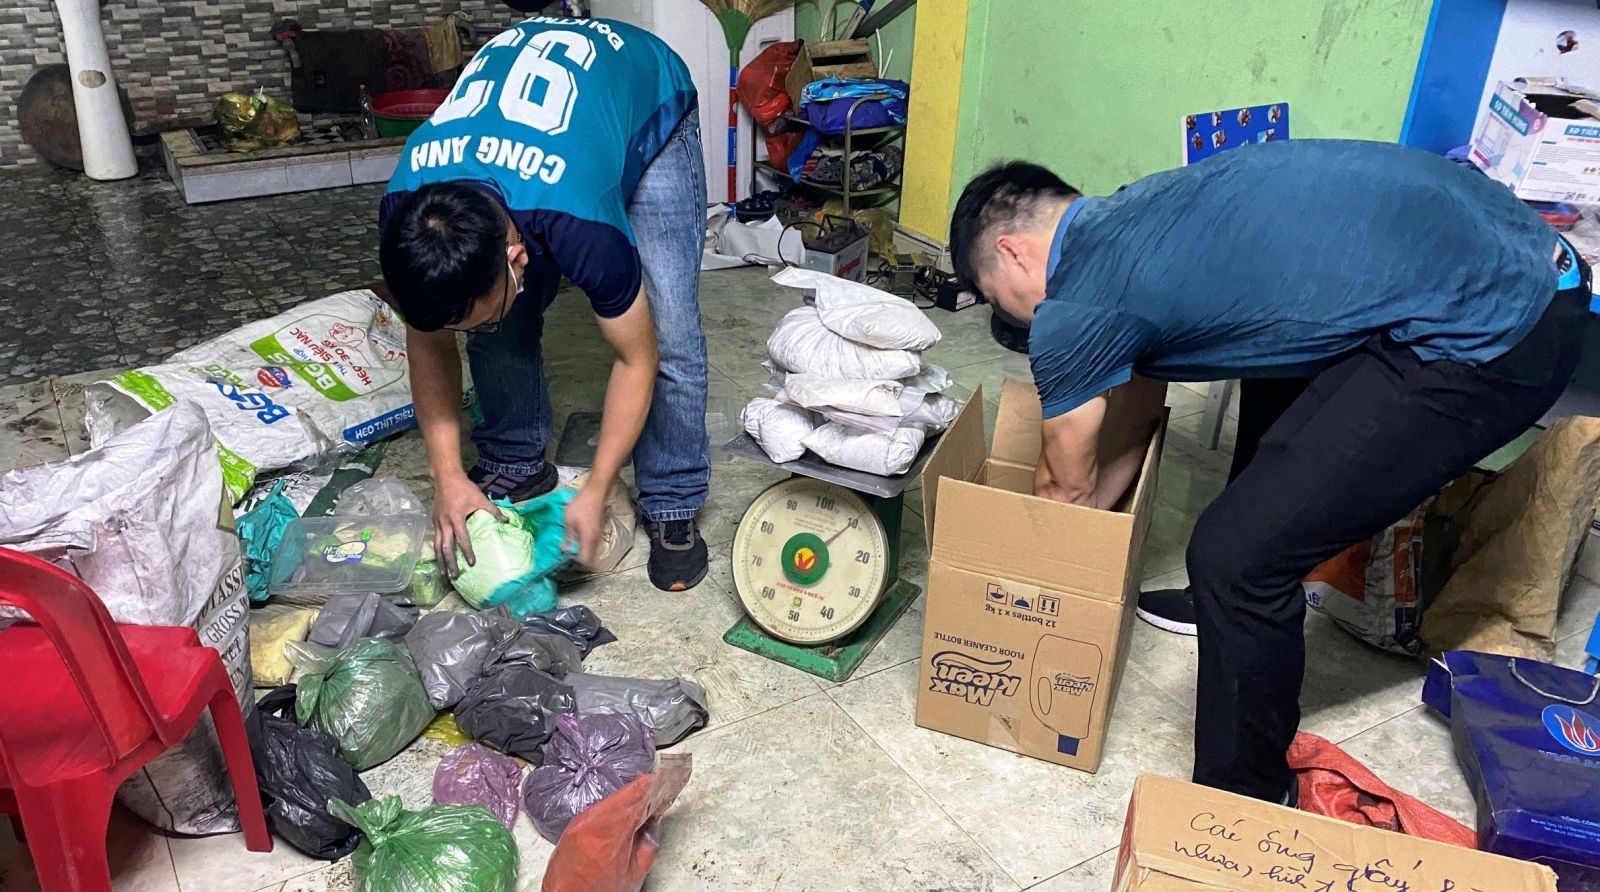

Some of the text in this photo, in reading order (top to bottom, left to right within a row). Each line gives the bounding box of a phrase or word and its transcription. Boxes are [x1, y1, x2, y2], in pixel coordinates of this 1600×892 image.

[430, 27, 597, 136] 93
[410, 135, 566, 185] CÔNG ANH
[289, 327, 334, 362] SIÊU NẠC
[355, 408, 414, 440] HEO THỊT SIÊU
[786, 499, 798, 512] 90
[815, 496, 835, 511] 100
[760, 521, 775, 535] 80
[751, 555, 763, 567] 70
[855, 550, 870, 565] 20
[762, 586, 776, 601] 60
[848, 586, 861, 598] 30
[788, 610, 800, 622] 50
[820, 607, 835, 621] 40
[984, 603, 996, 615] kg
[998, 608, 1004, 616] 1
[205, 603, 242, 643] GROSS
[1012, 612, 1043, 626] bottles
[1045, 619, 1057, 628] 12
[933, 631, 1025, 660] FLOOR CLEANER BOTTLE
[929, 676, 997, 707] Max
[1053, 683, 1083, 697] Max
